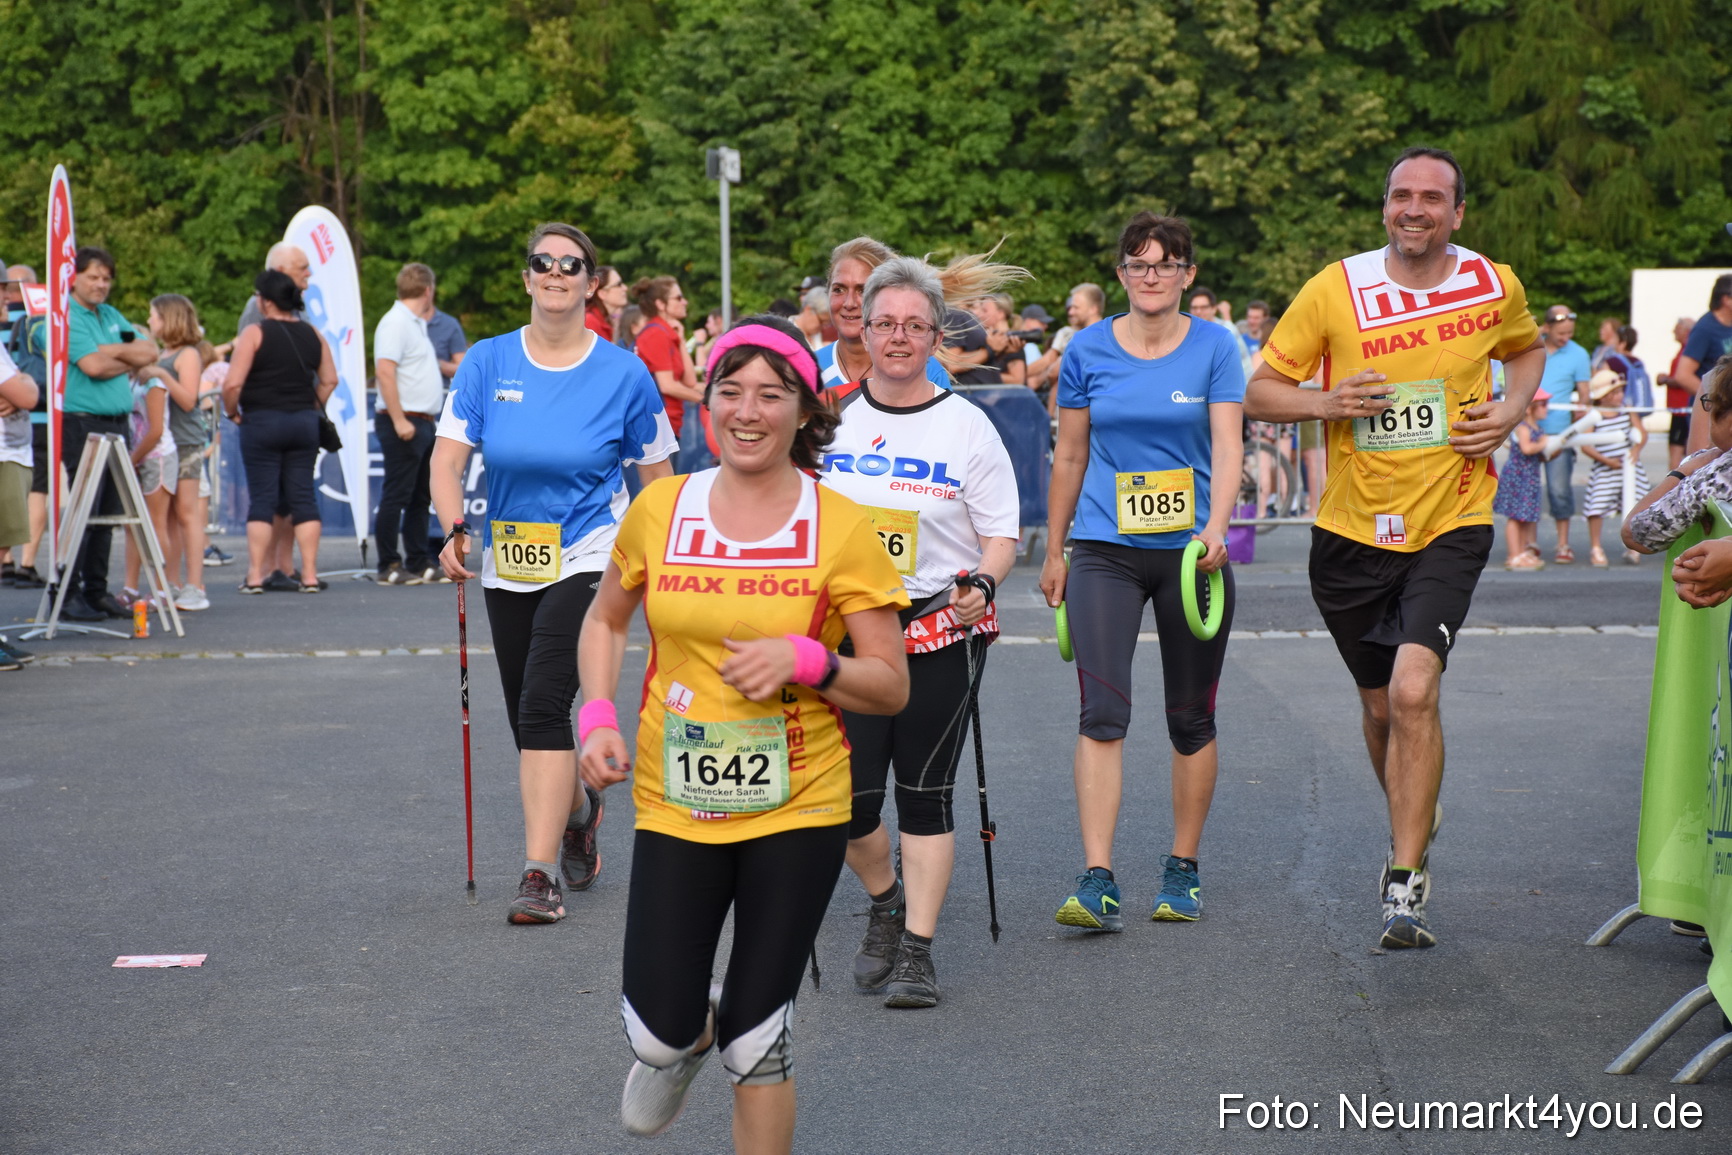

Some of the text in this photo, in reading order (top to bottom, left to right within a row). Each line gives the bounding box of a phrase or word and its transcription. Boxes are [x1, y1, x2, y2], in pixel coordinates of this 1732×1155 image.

[1361, 310, 1503, 359] MAX BÖGL
[1267, 340, 1299, 368] -boegl.de
[1363, 404, 1434, 433] 1619
[1367, 430, 1433, 441] Kraußer Sebastian
[889, 481, 957, 500] energie
[1127, 491, 1185, 516] 1085
[501, 542, 551, 566] 1065
[656, 574, 818, 597] MAX BÖGL
[755, 743, 779, 753] 2019
[677, 751, 771, 786] 1642
[683, 784, 765, 796] Niefnecker Sarah
[693, 794, 708, 803] Bögl
